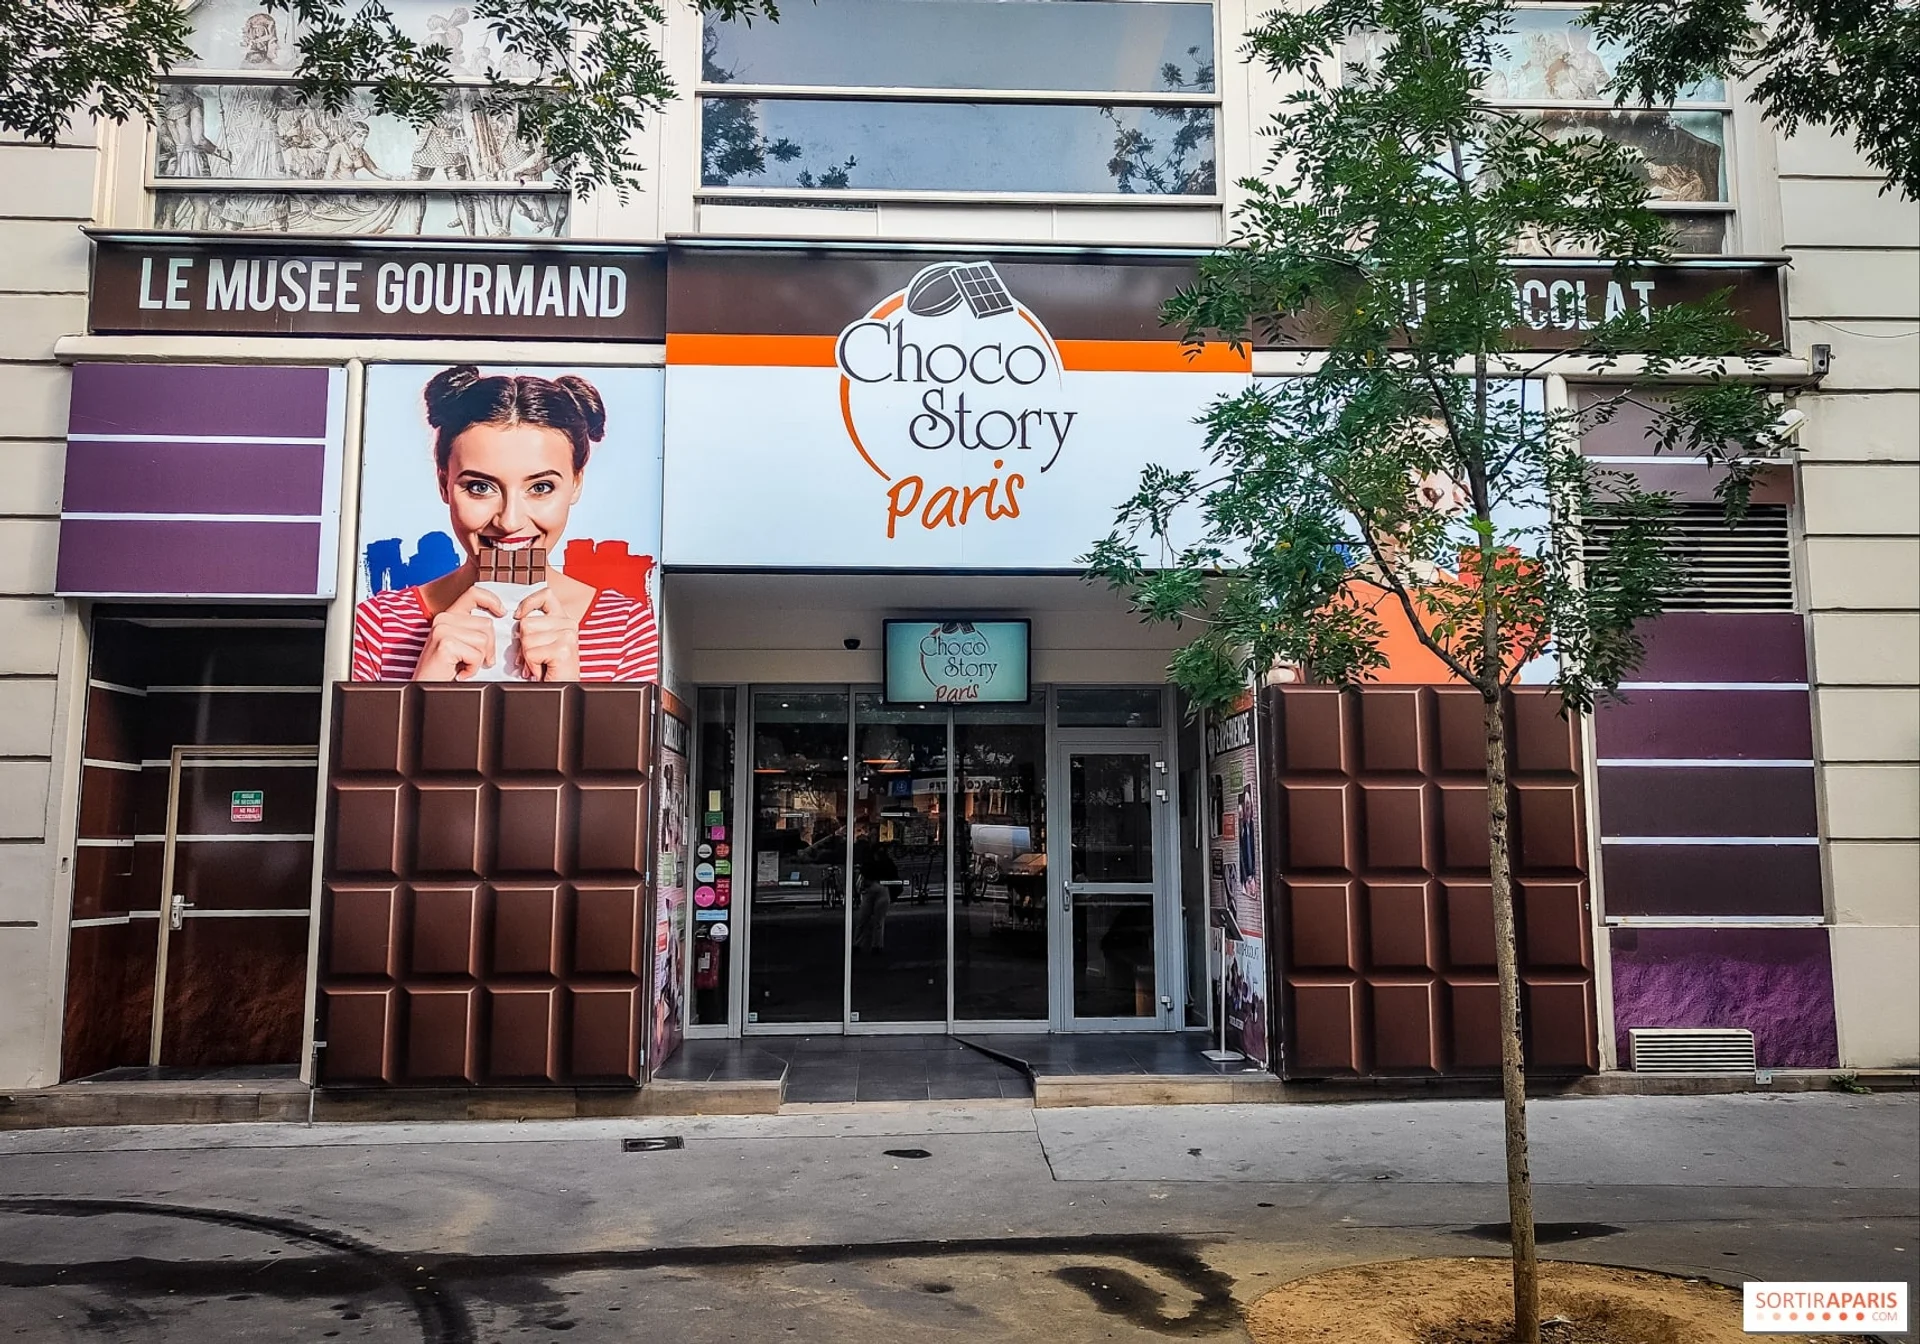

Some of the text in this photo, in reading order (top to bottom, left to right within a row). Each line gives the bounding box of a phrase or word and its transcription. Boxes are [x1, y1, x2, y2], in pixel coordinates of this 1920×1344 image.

[138, 257, 628, 319] LE MUSEE GOURMAND
[839, 318, 1047, 385] Choco
[909, 387, 1079, 473] Story
[920, 634, 987, 656] Choco
[945, 656, 998, 684] Story
